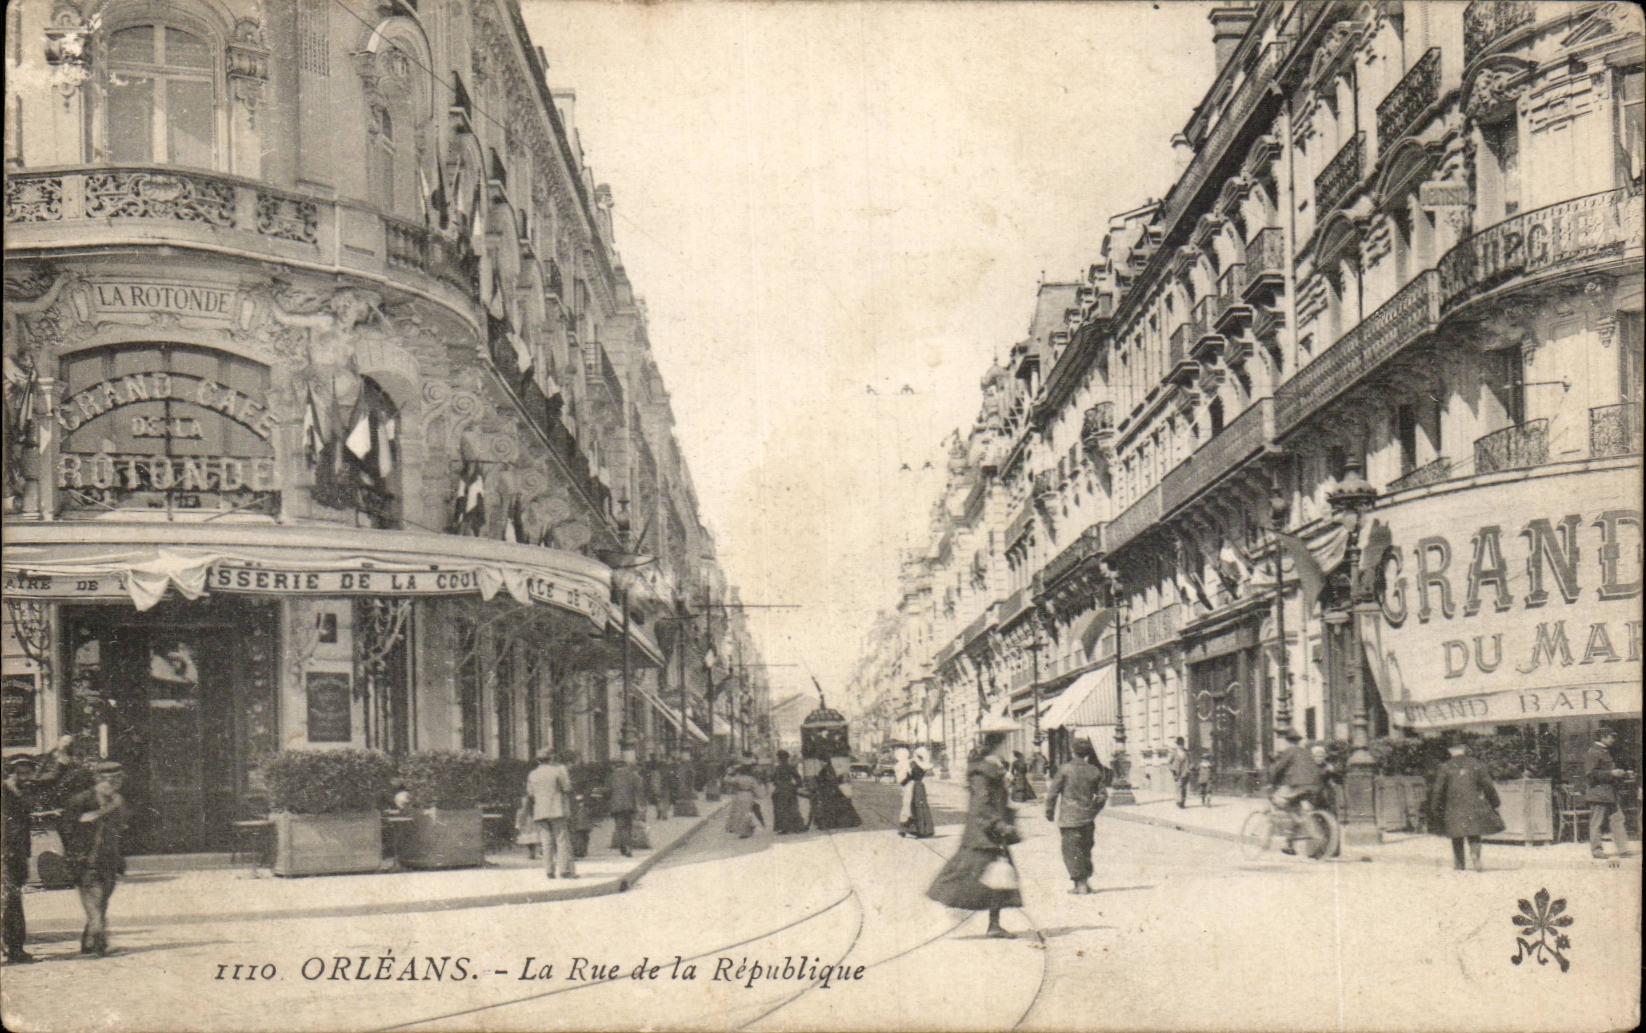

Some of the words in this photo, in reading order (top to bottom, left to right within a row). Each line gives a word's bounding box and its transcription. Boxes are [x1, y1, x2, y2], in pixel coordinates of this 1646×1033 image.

[97, 286, 124, 307] LA
[130, 286, 233, 313] ROTONDE
[55, 373, 172, 431] GRAND
[57, 453, 276, 491] ROTONDE
[76, 580, 98, 591] DE
[340, 572, 370, 589] DE
[391, 573, 417, 589] LA
[1375, 509, 1642, 628] GRAND
[1441, 632, 1503, 680] DU
[1404, 699, 1489, 723] GRAND
[1518, 689, 1612, 713] BAR
